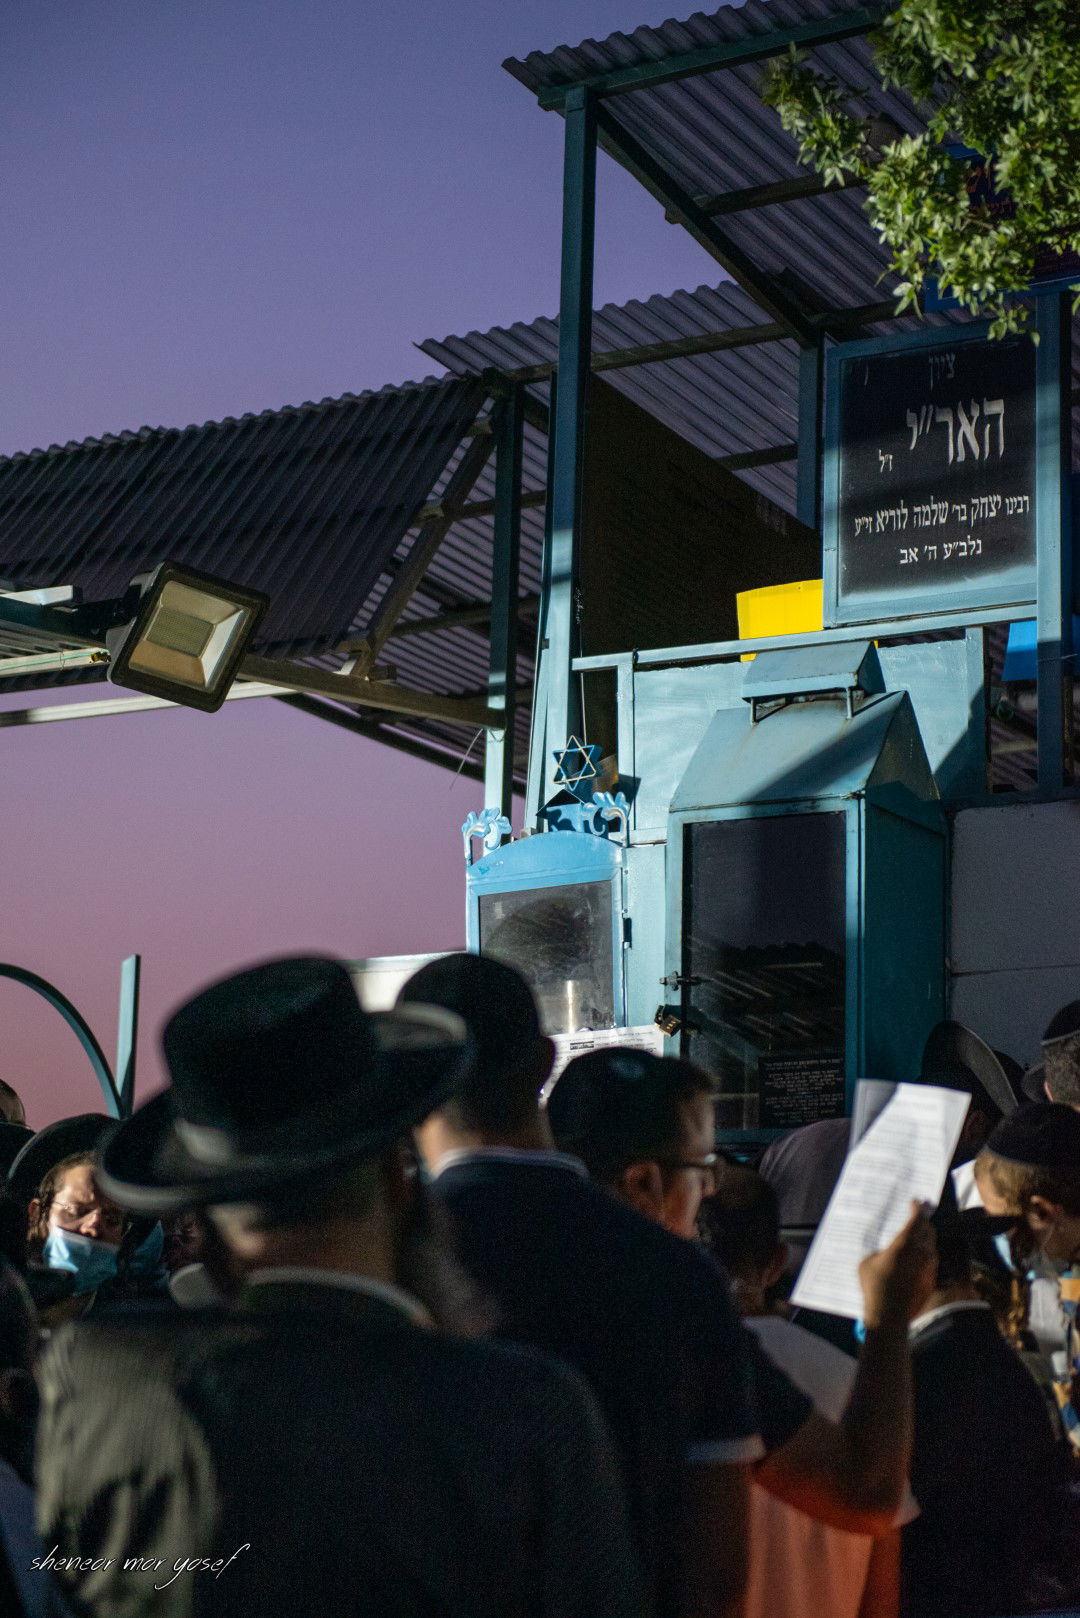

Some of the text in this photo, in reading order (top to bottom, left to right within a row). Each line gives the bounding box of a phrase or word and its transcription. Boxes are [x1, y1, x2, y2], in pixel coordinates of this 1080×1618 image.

[875, 499, 909, 533] לוריא
[913, 495, 949, 528] שלמה
[970, 494, 1002, 528] יצחק
[1005, 495, 1030, 516] רבינו
[899, 546, 919, 565] אב
